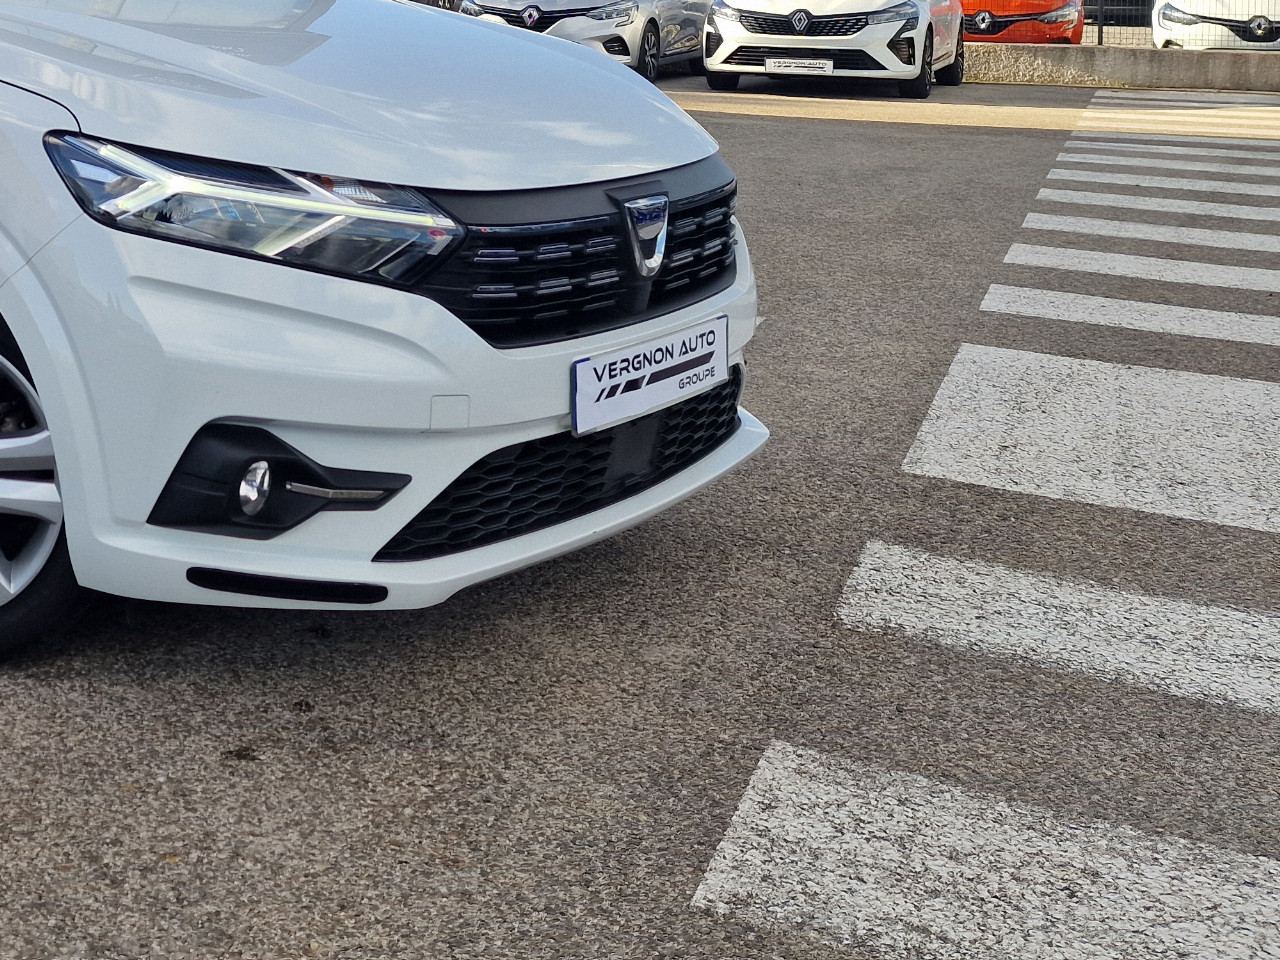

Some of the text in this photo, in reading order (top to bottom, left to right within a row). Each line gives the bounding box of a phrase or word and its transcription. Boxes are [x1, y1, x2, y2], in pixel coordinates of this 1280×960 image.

[593, 329, 716, 383] VERGNON AUTO
[679, 366, 716, 390] GROUPE
